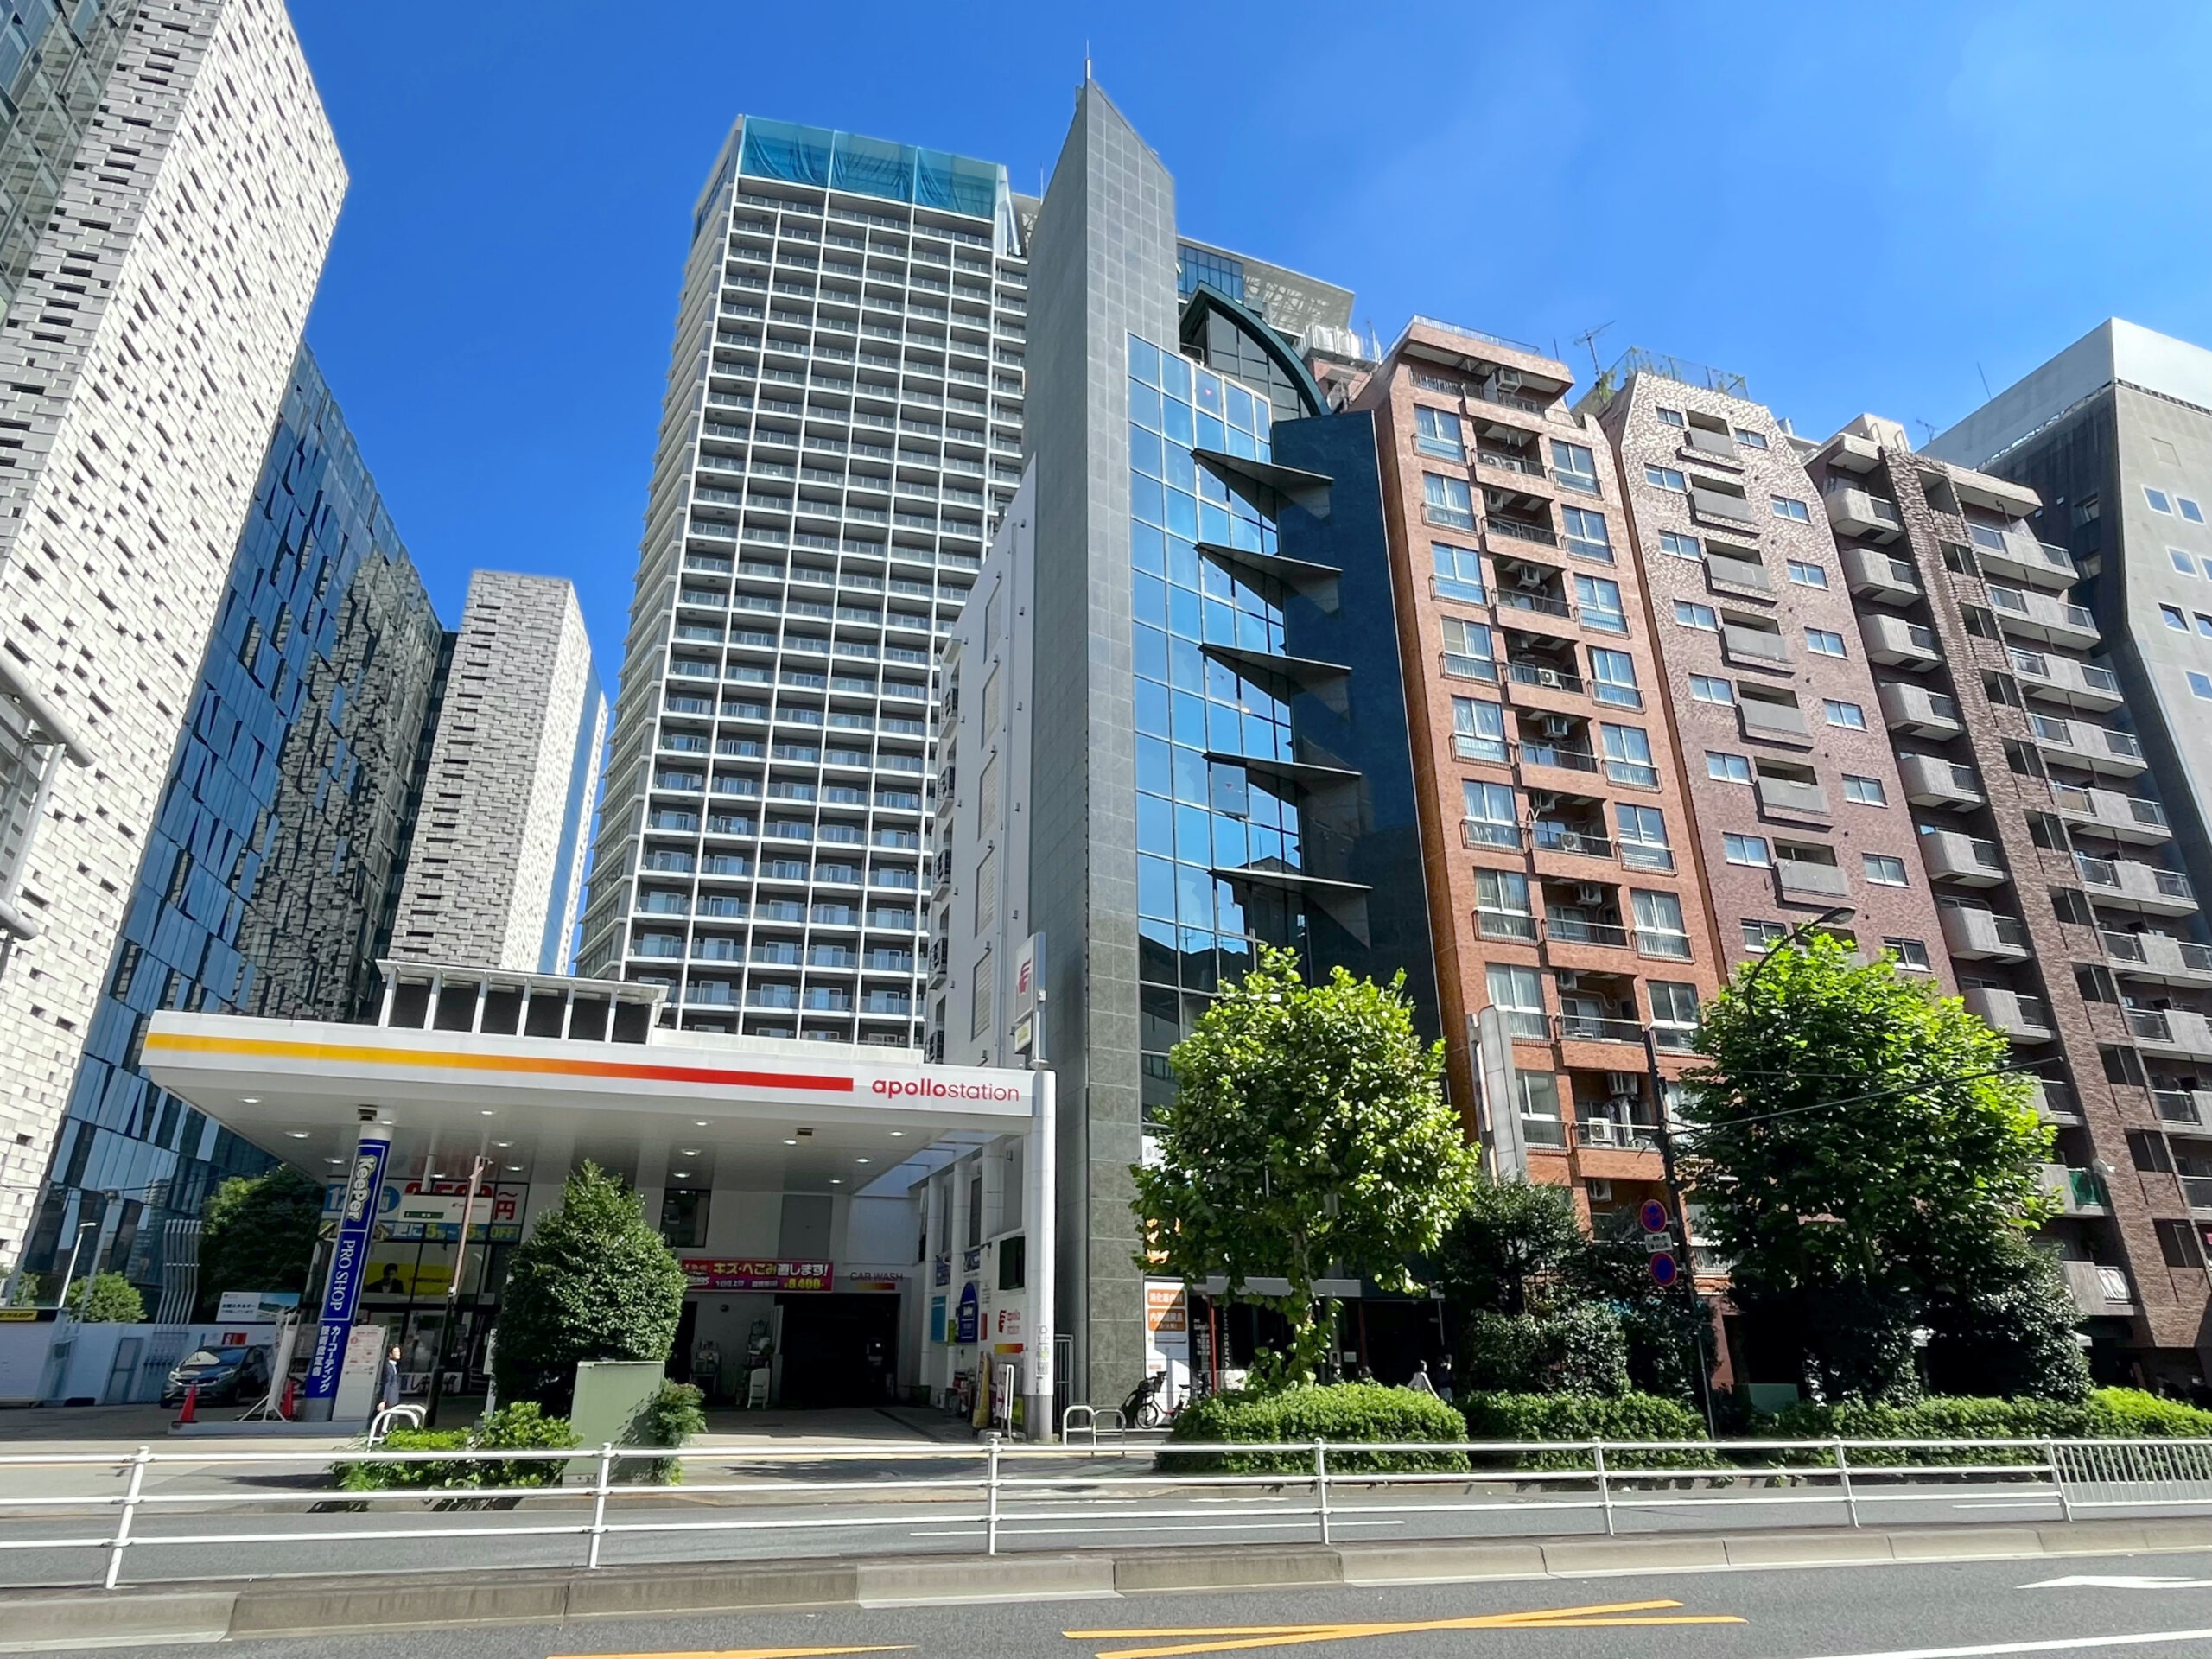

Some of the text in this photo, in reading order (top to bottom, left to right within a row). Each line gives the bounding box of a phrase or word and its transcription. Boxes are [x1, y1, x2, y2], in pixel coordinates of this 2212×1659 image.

[872, 1077, 1020, 1102] apollostation
[329, 1239, 356, 1312] PRO SHOP
[850, 1272, 903, 1281] CAR WASH
[319, 1325, 341, 1394] カーコーティング
